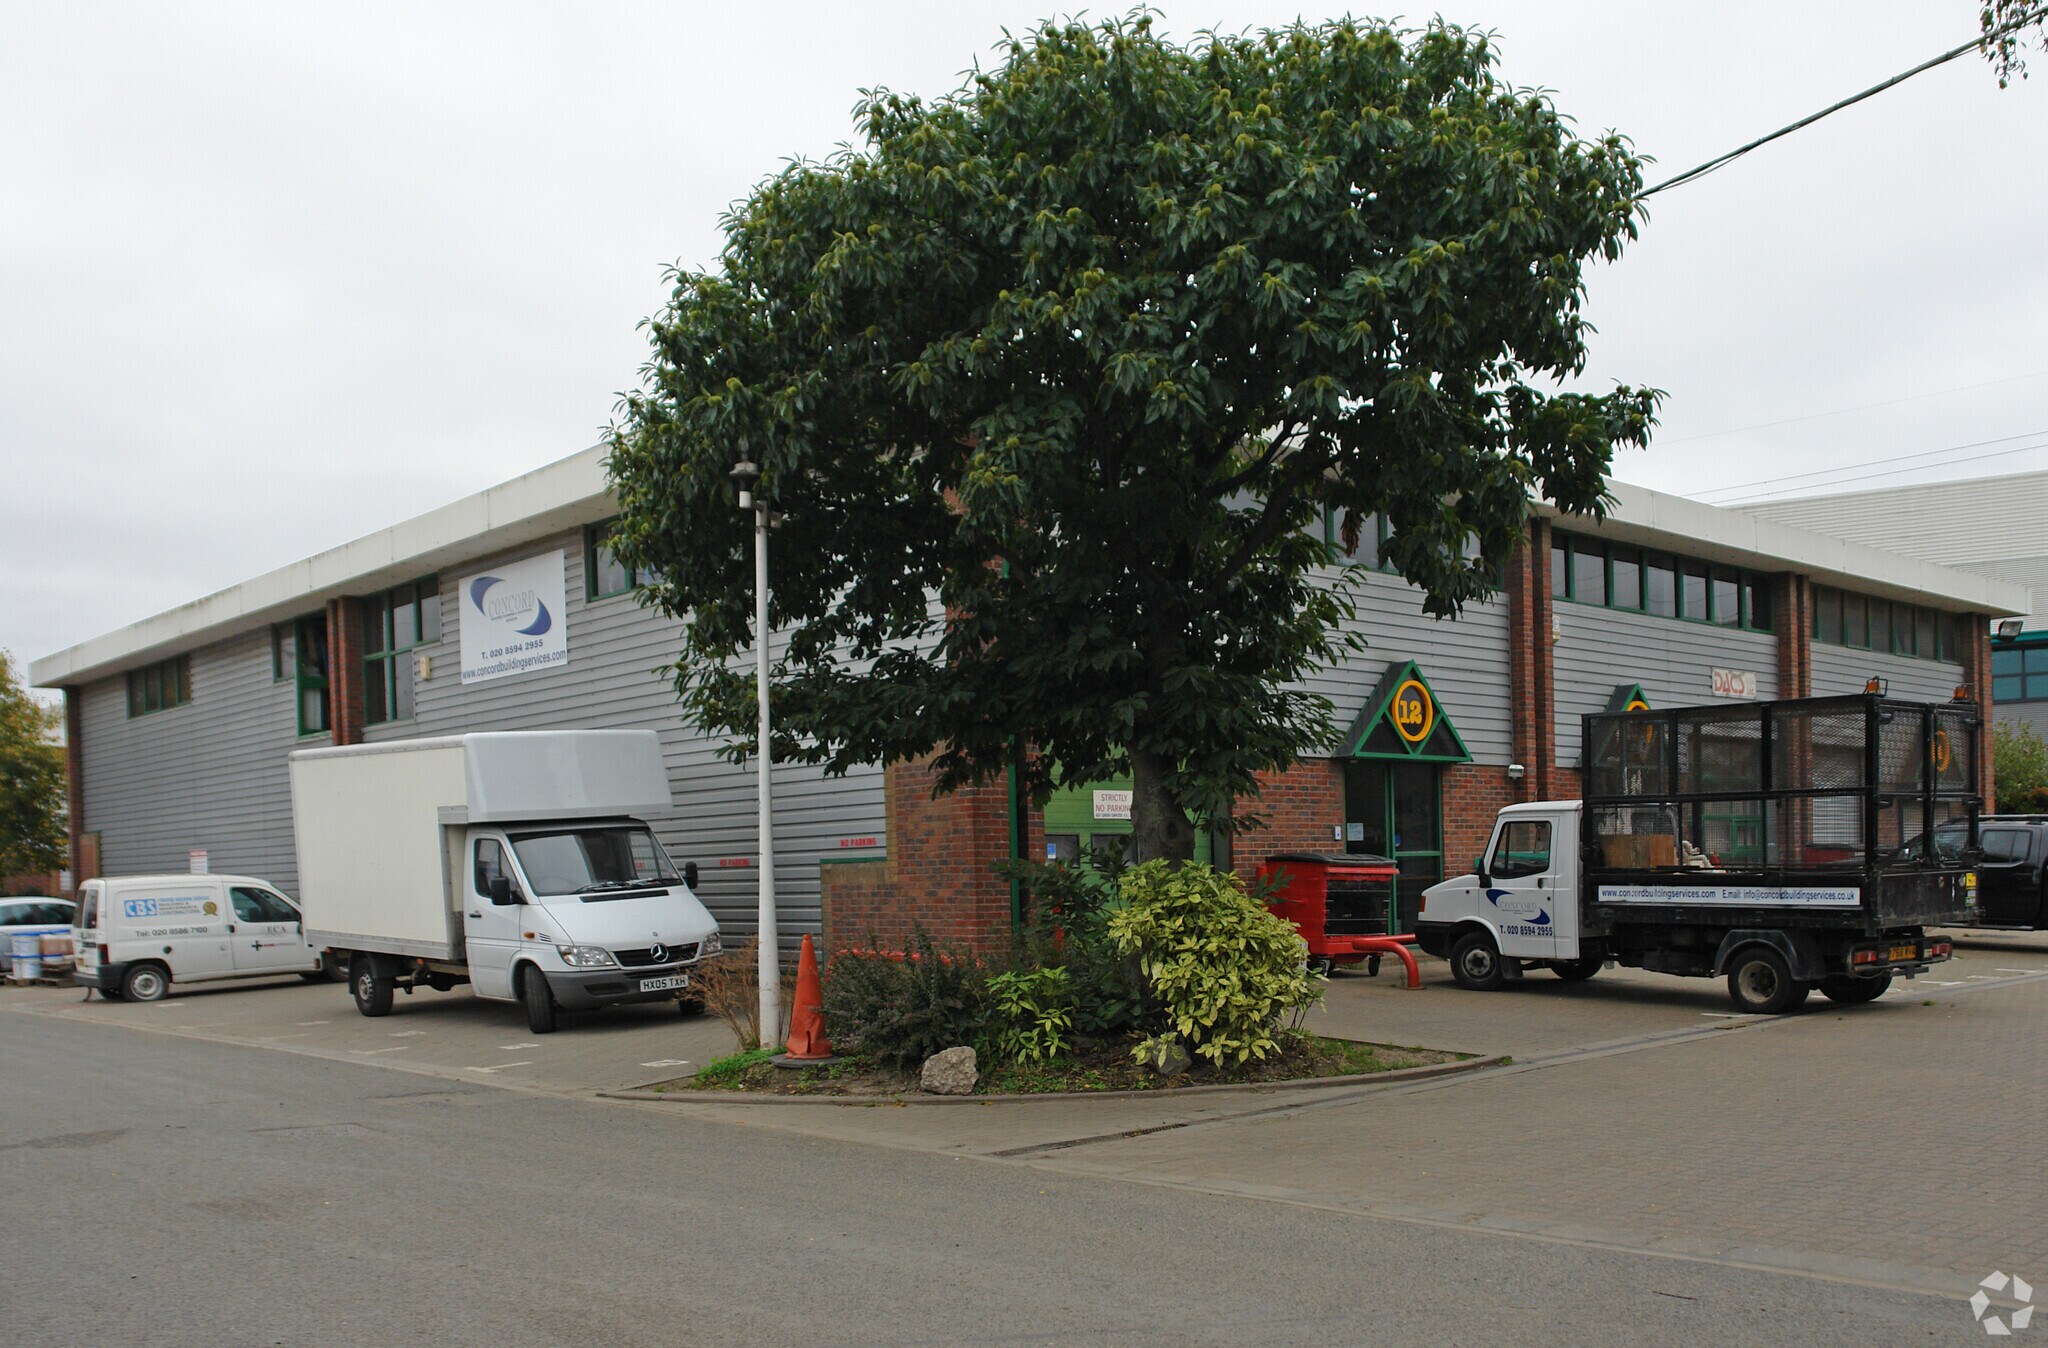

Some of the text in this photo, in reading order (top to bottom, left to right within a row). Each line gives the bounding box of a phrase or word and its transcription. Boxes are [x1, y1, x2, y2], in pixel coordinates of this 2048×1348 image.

[488, 590, 535, 617] CONCORD
[481, 639, 544, 659] T. 020 8594 2955
[462, 649, 567, 679] www.concordbuildingservices.com
[1400, 700, 1422, 724] 12
[1101, 793, 1128, 802] STRICTLY
[1095, 804, 1131, 812] NO PARKIN
[840, 837, 877, 847] NO PARKING
[719, 858, 750, 867] NO PARKING
[126, 900, 156, 916] CBS
[1500, 901, 1537, 911] CONCORD
[266, 926, 287, 934] ECA
[1500, 925, 1553, 936] T. 020 8594 2955
[643, 977, 686, 990] HX05 TXH
